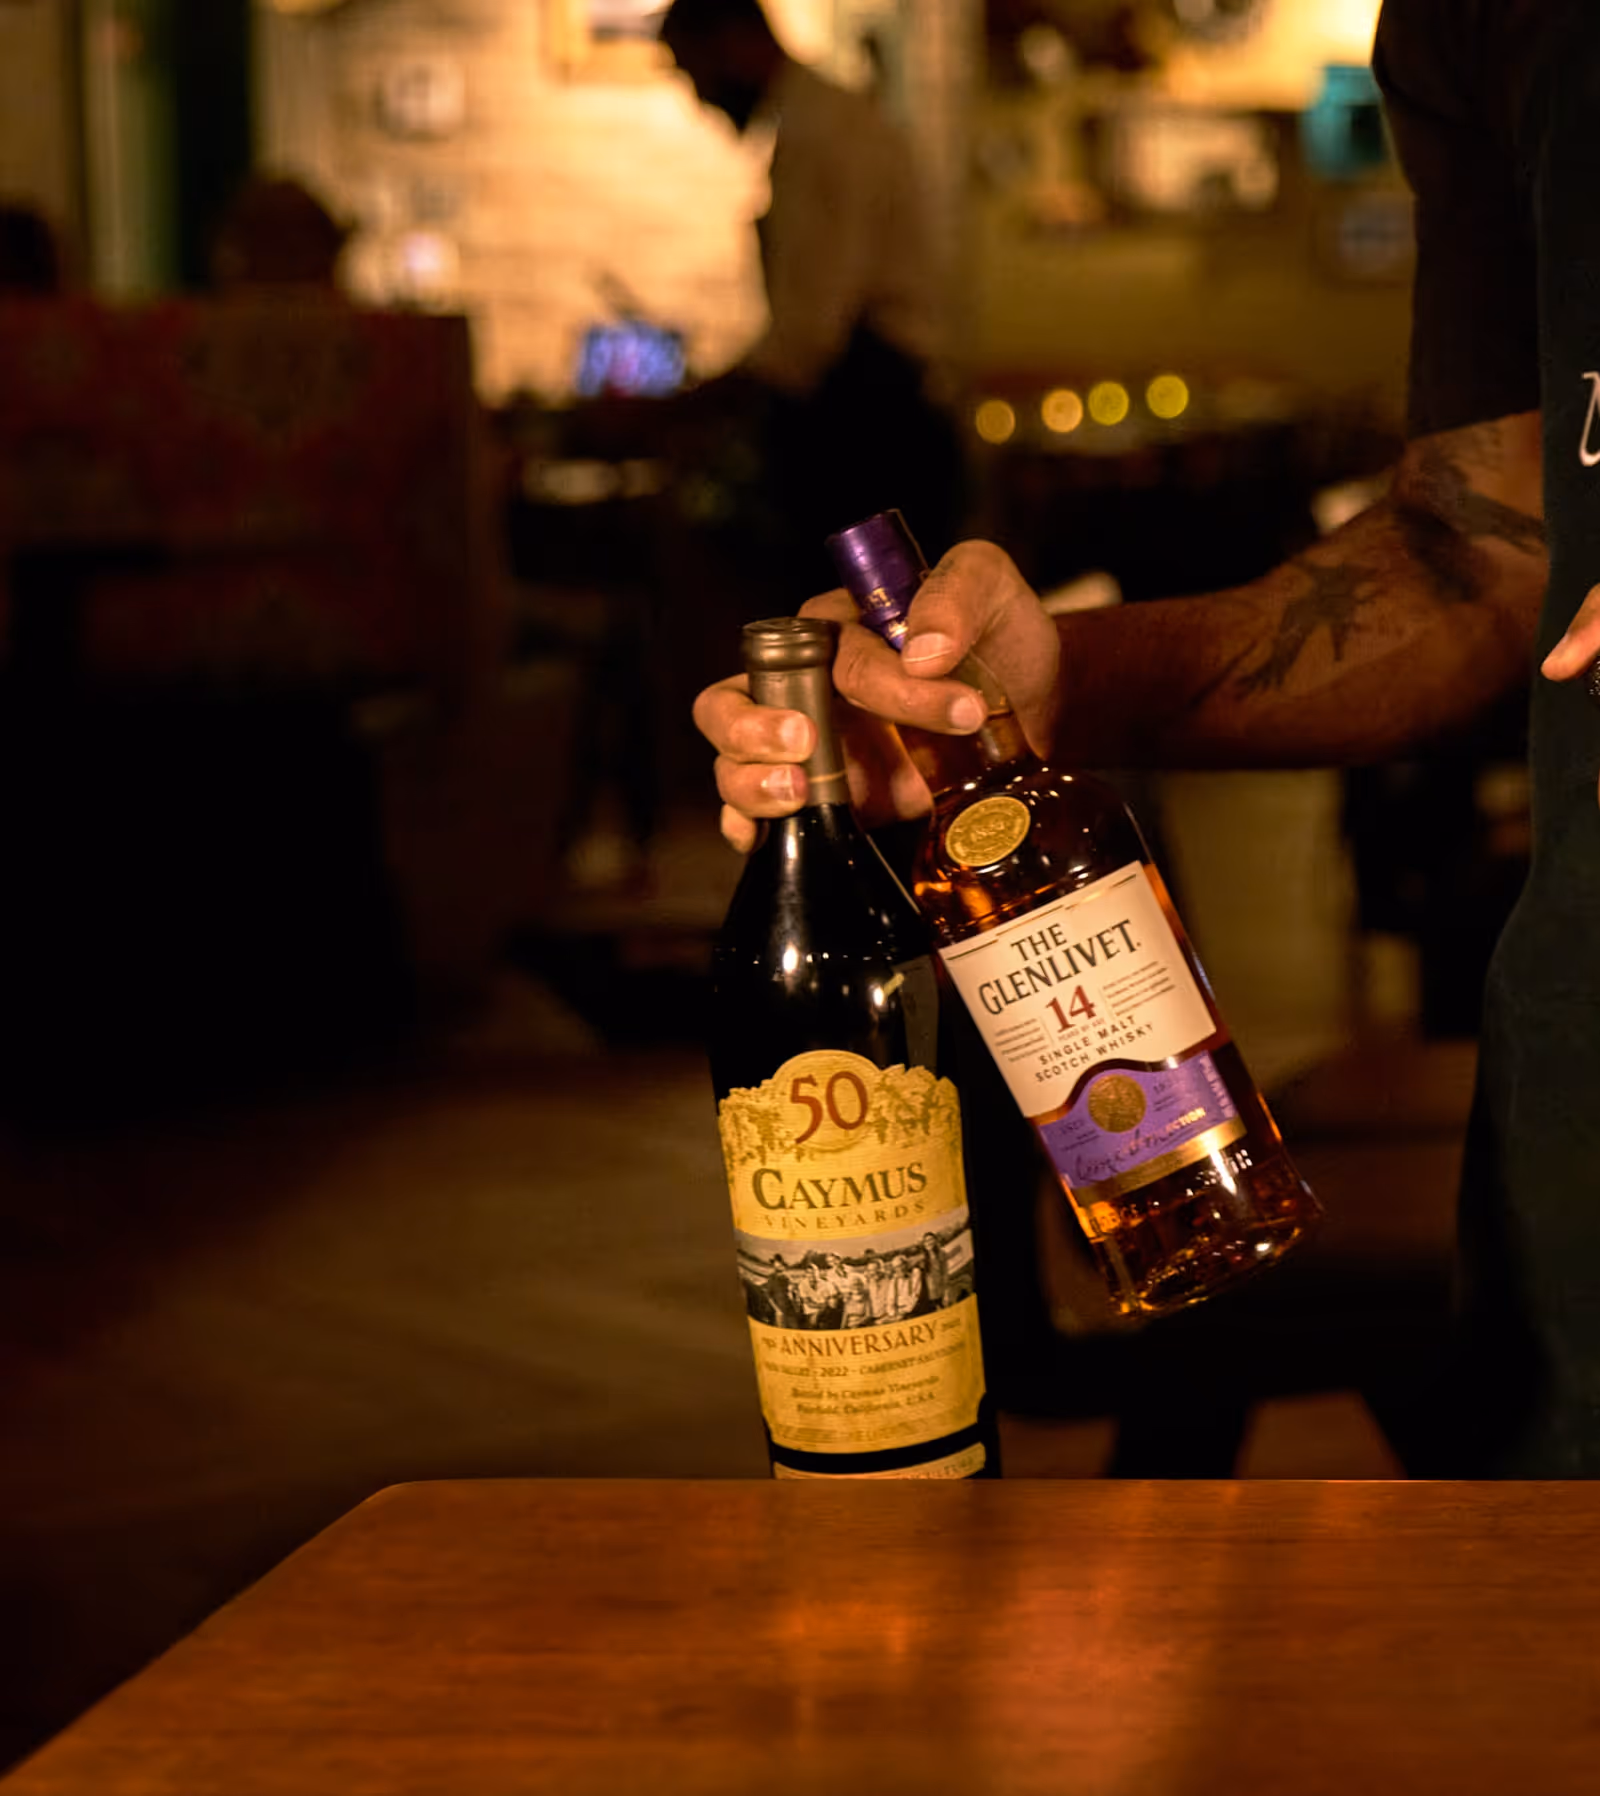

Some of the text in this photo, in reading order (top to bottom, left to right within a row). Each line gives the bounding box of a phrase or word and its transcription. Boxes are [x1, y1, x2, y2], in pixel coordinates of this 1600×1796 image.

[1010, 923, 1068, 961] THE
[1045, 985, 1096, 1033] 14
[1035, 1024, 1153, 1083] SCOTCH WHISKY
[1039, 1037, 1091, 1066] SINGLE
[1097, 1015, 1136, 1038] MALT
[790, 1071, 868, 1144] 50
[752, 1162, 927, 1210] CAYMUS
[763, 1203, 926, 1230] VINEYARDS
[780, 1320, 939, 1357] ANNIVERSARY
[821, 1366, 848, 1378] 2022
